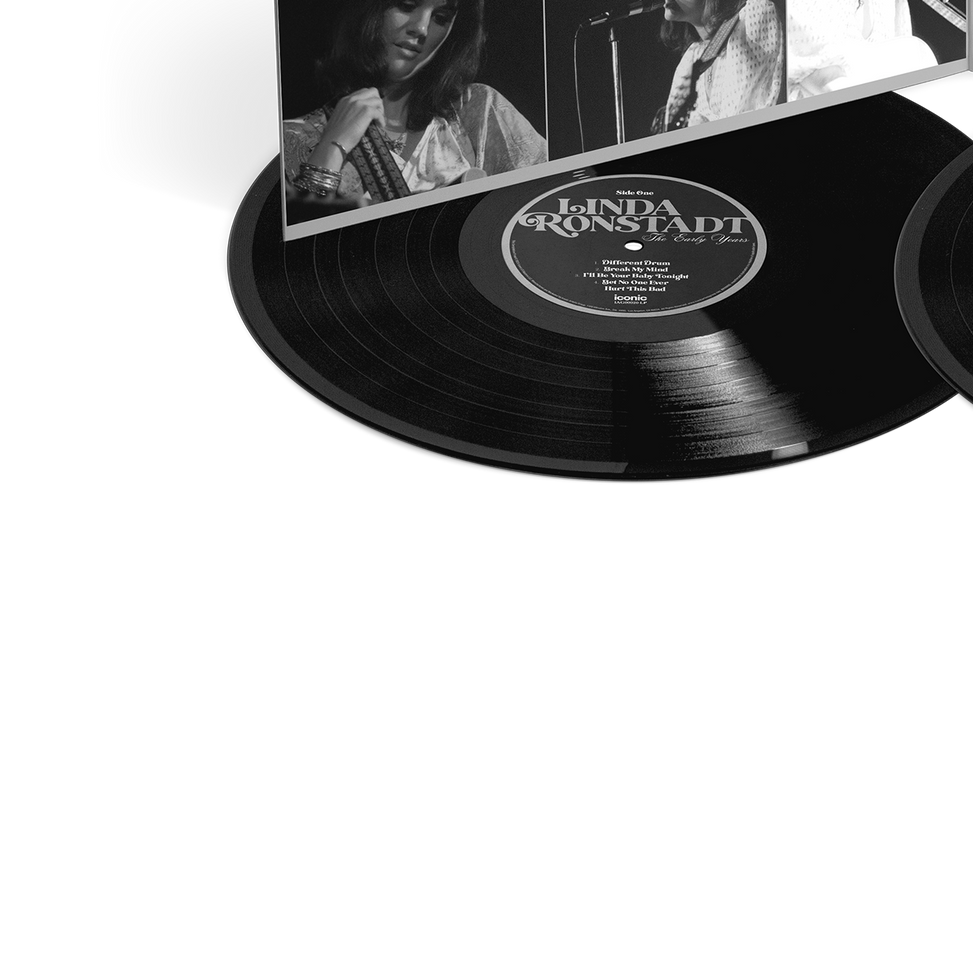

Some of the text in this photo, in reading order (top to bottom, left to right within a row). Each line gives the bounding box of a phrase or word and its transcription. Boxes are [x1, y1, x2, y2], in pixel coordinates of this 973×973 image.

[558, 198, 681, 215] LINDA
[517, 212, 749, 238] RONSTADT
[642, 233, 749, 245] The Early Years
